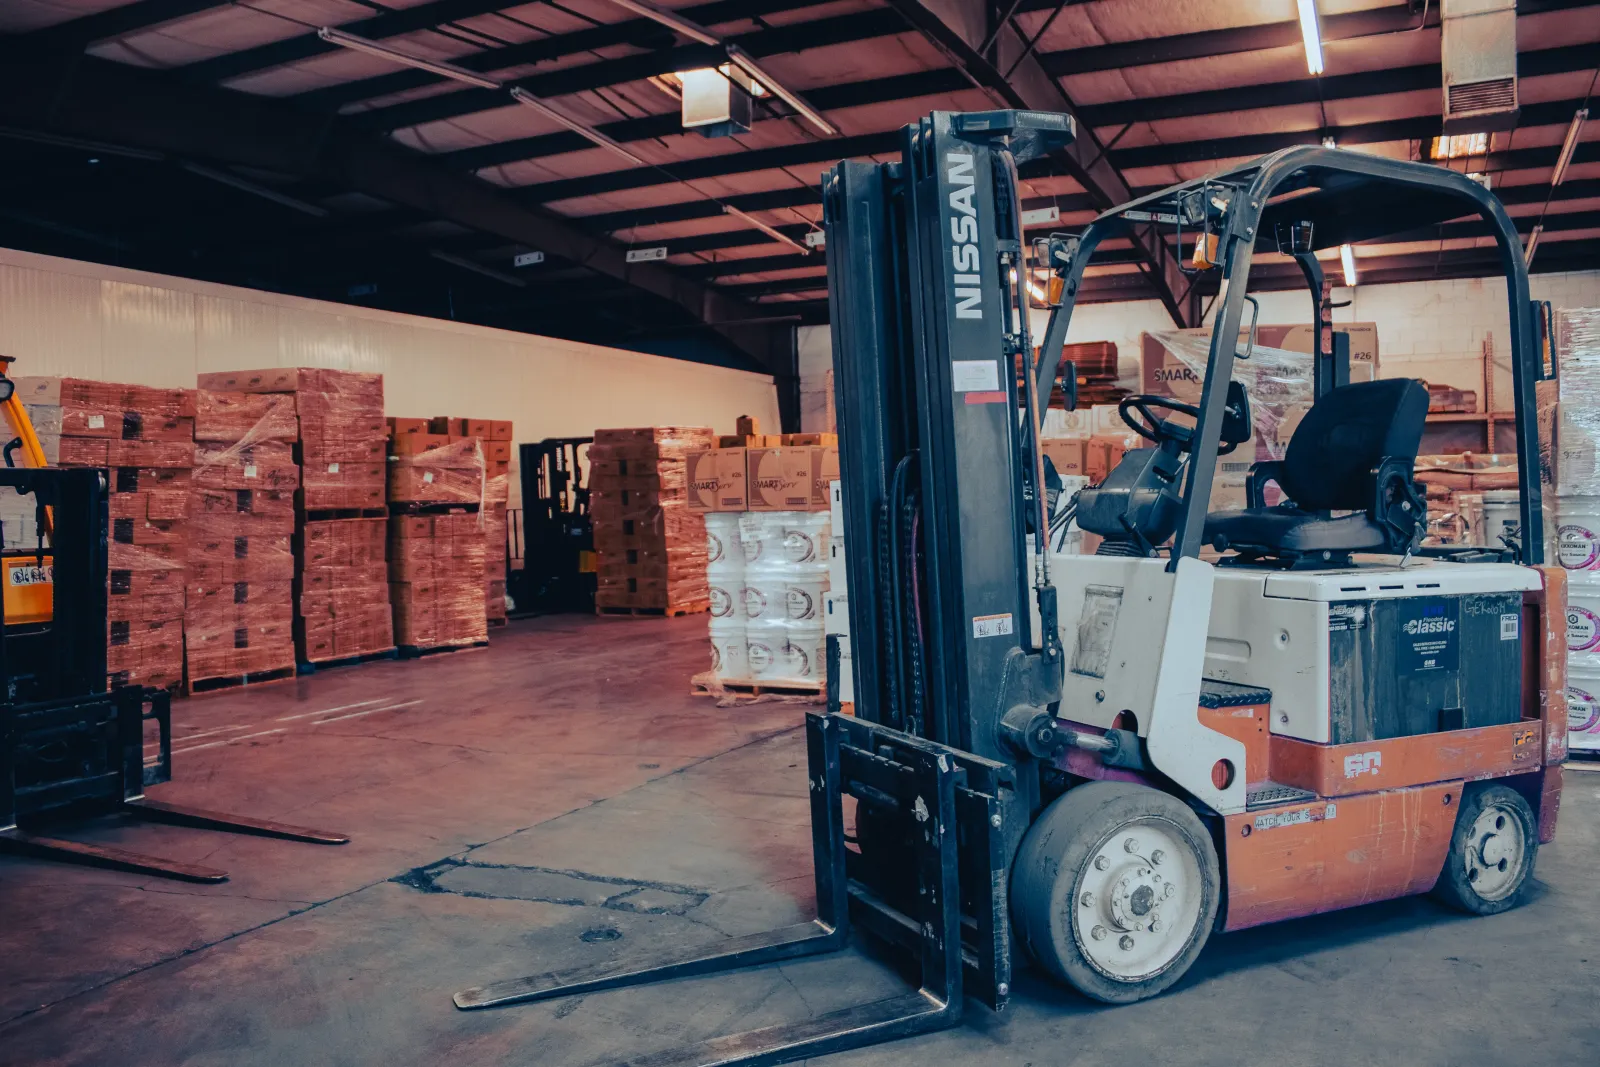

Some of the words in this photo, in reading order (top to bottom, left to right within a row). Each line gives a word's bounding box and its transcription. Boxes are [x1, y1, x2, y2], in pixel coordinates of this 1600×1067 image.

[946, 152, 983, 320] NISSAN
[1354, 351, 1372, 360] #26
[1154, 368, 1198, 383] SMAR
[1408, 617, 1455, 634] Classic
[1255, 815, 1278, 828] WATCH
[1283, 811, 1301, 823] YOUR
